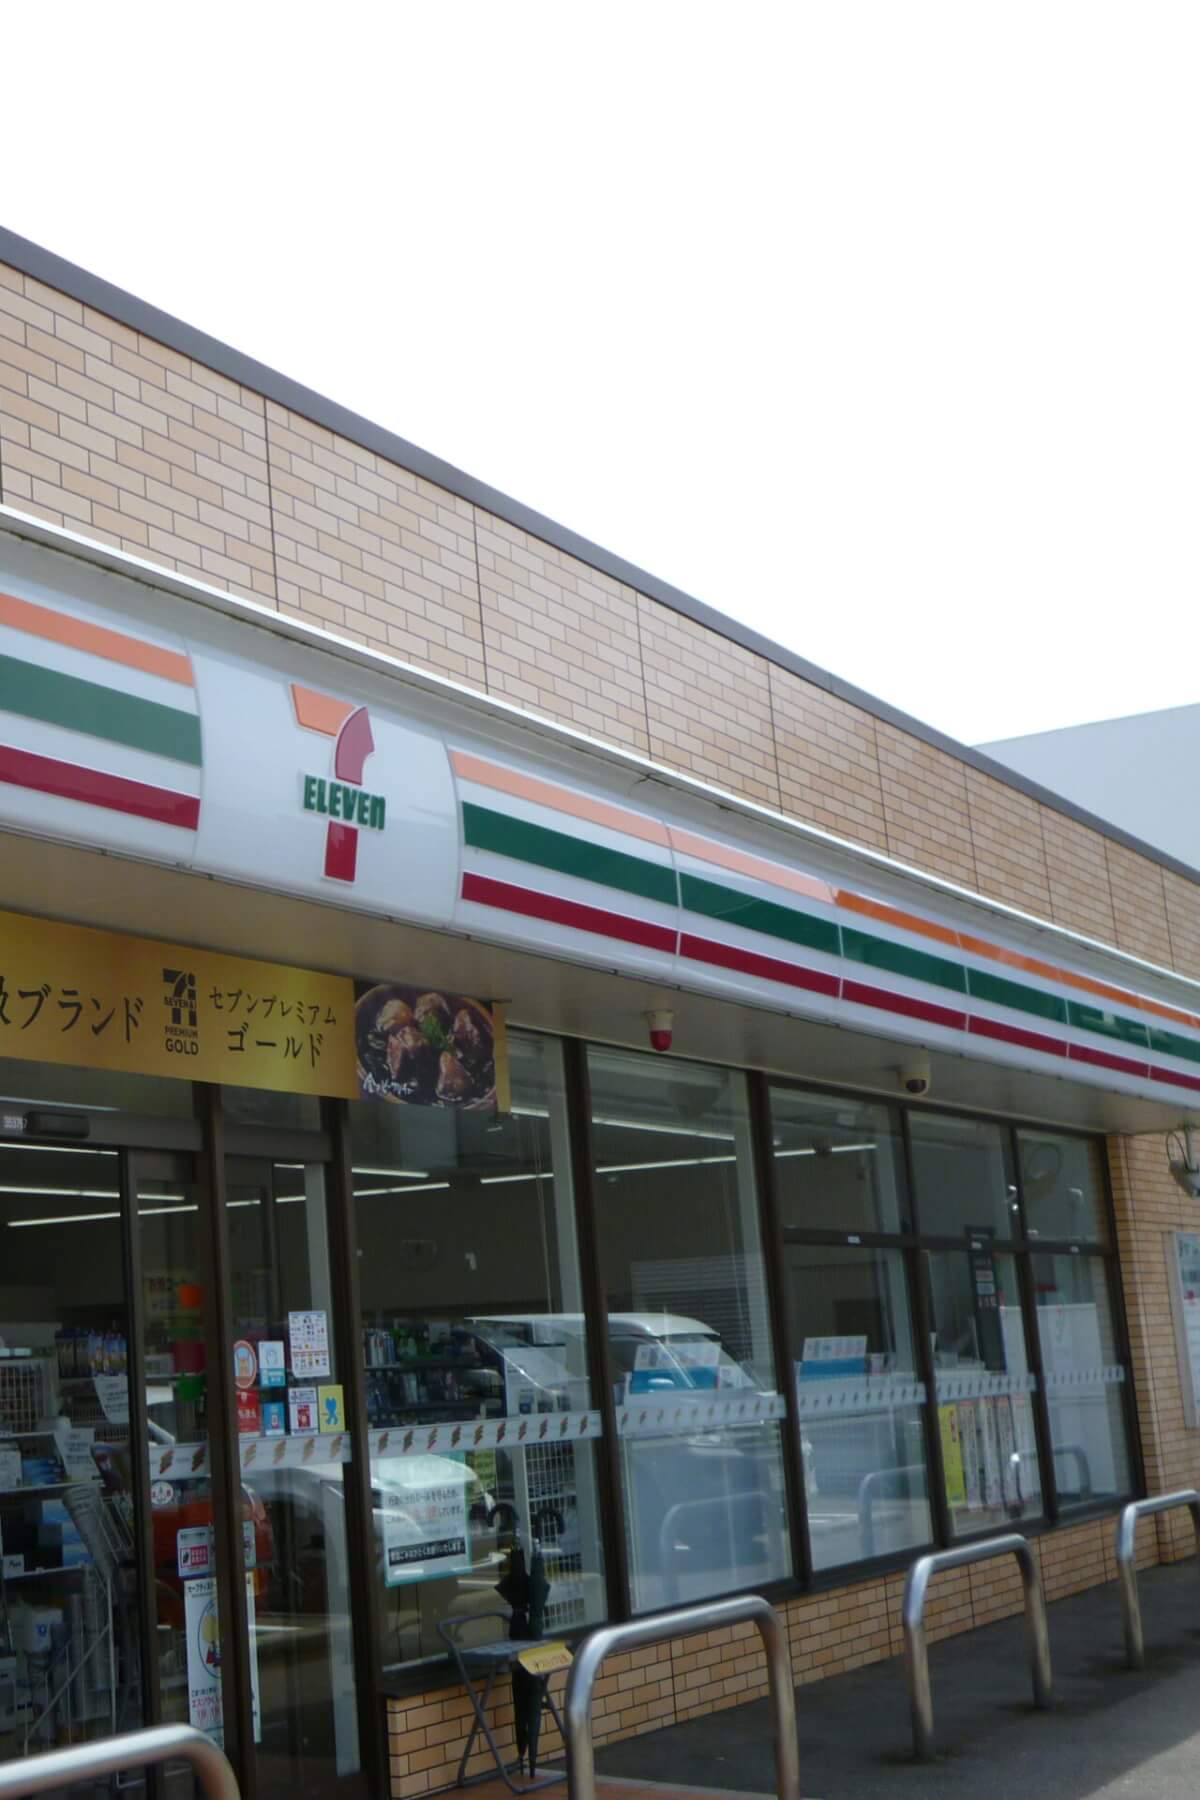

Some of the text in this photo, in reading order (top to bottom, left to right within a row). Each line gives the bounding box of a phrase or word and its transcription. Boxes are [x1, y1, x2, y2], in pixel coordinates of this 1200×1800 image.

[209, 986, 336, 1026] セブンプレミアム
[165, 1025, 198, 1038] PREMIUM
[227, 1022, 324, 1068] ゴールド
[165, 1038, 199, 1055] GOLD
